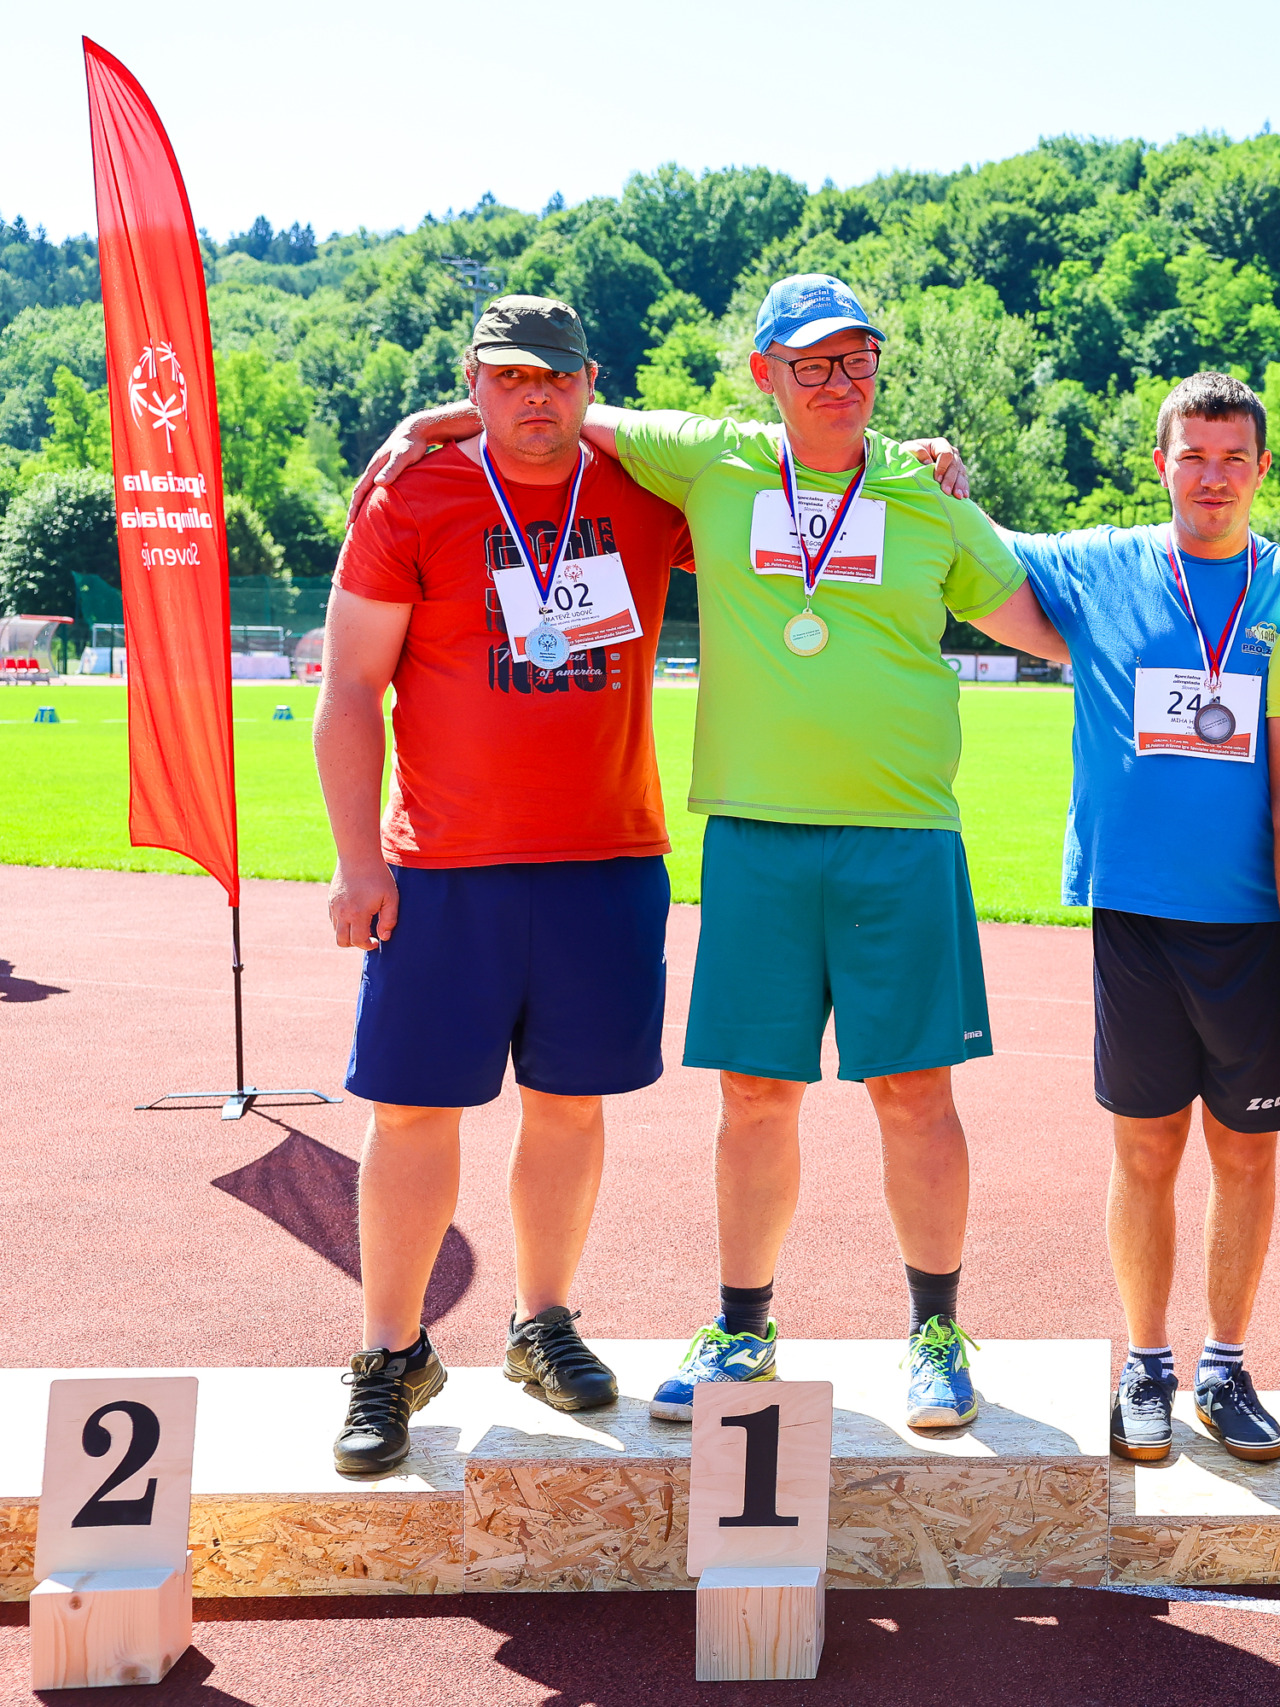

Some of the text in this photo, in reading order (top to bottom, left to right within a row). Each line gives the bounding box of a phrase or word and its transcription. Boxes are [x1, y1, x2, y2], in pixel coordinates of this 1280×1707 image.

[789, 513, 847, 540] 10
[556, 667, 603, 676] america
[1167, 691, 1220, 715] 24
[72, 1401, 159, 1527] 2
[719, 1405, 798, 1527] 1
